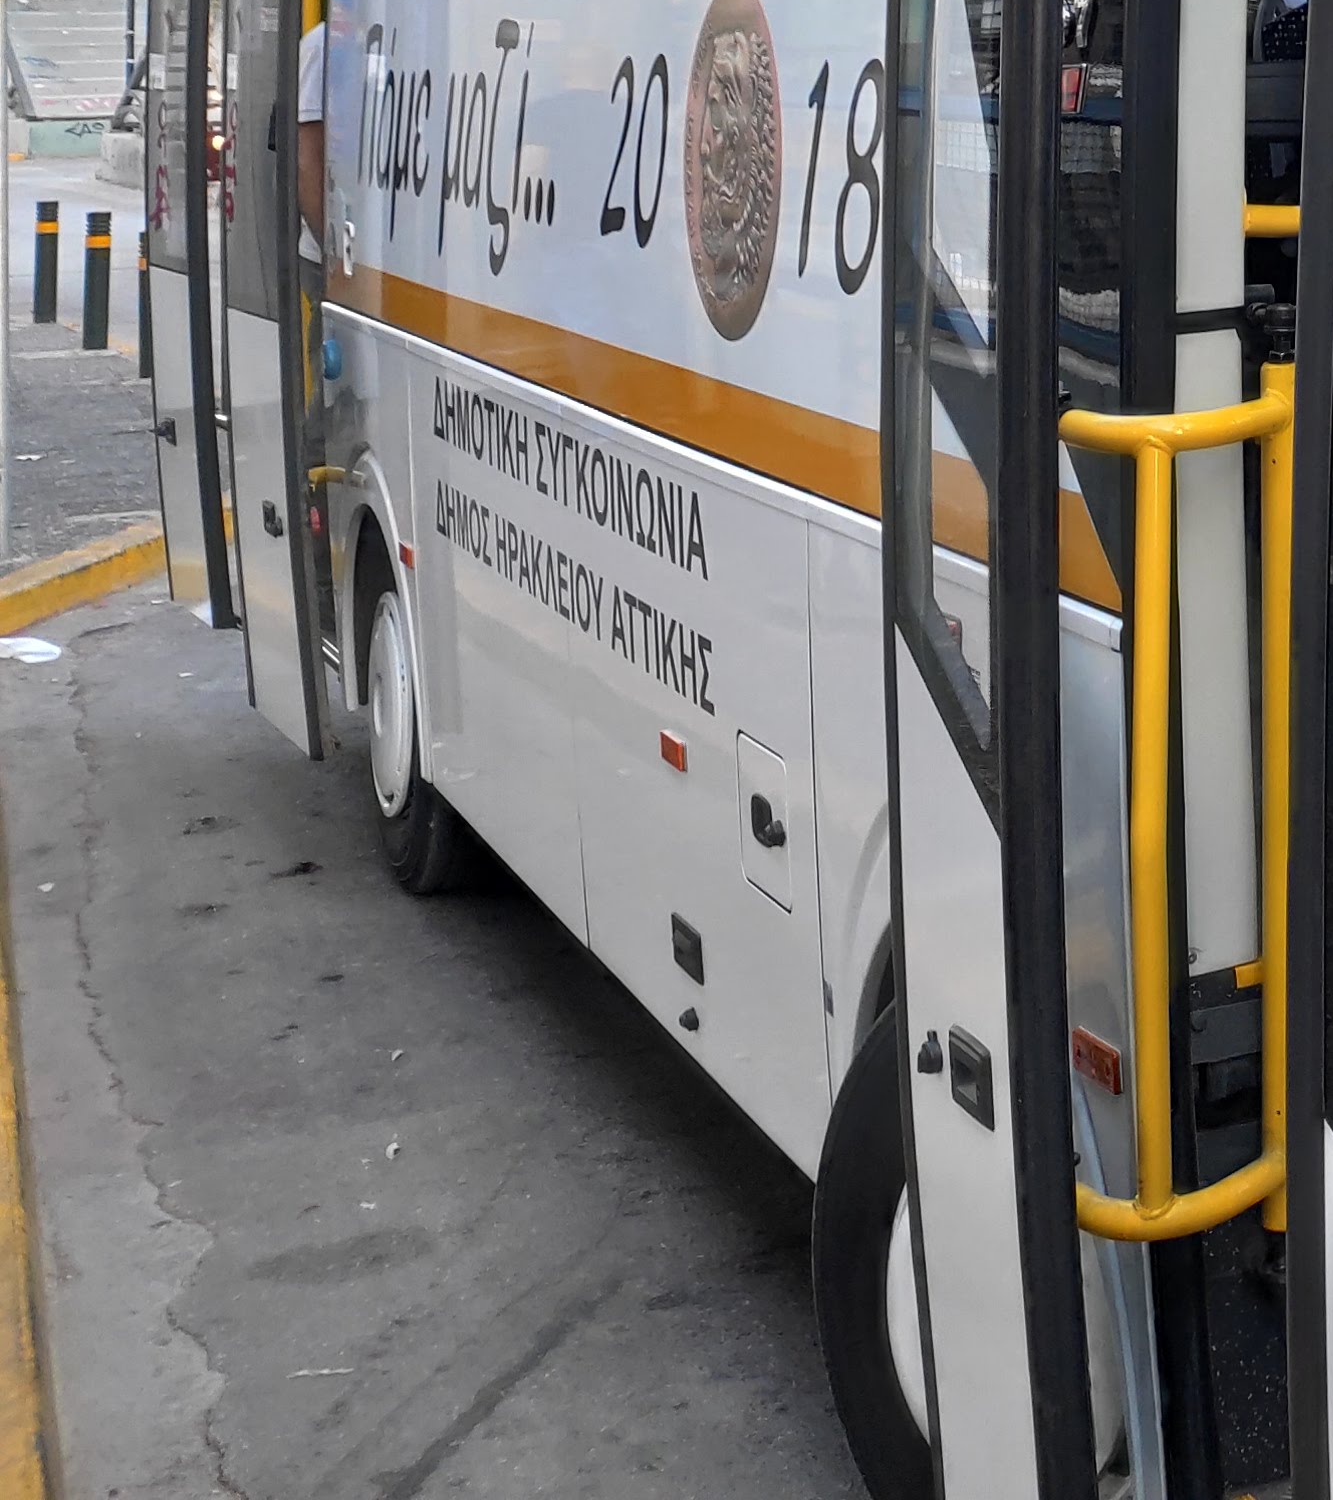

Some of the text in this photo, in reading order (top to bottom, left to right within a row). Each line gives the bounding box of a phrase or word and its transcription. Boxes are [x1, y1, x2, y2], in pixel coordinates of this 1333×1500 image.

[358, 23, 431, 242] Πάμε
[600, 54, 669, 249] 20
[798, 59, 884, 295] 18
[434, 376, 709, 581] ΔΗΜΟΤΙΚΗ ΣΥΓΚΟΙΝΩΝΙΑ
[436, 479, 715, 717] ΔΗΜΟΣ ΗΡΑΚΛΕΙΟΥ ΑΤΤΙΚΗΣ
